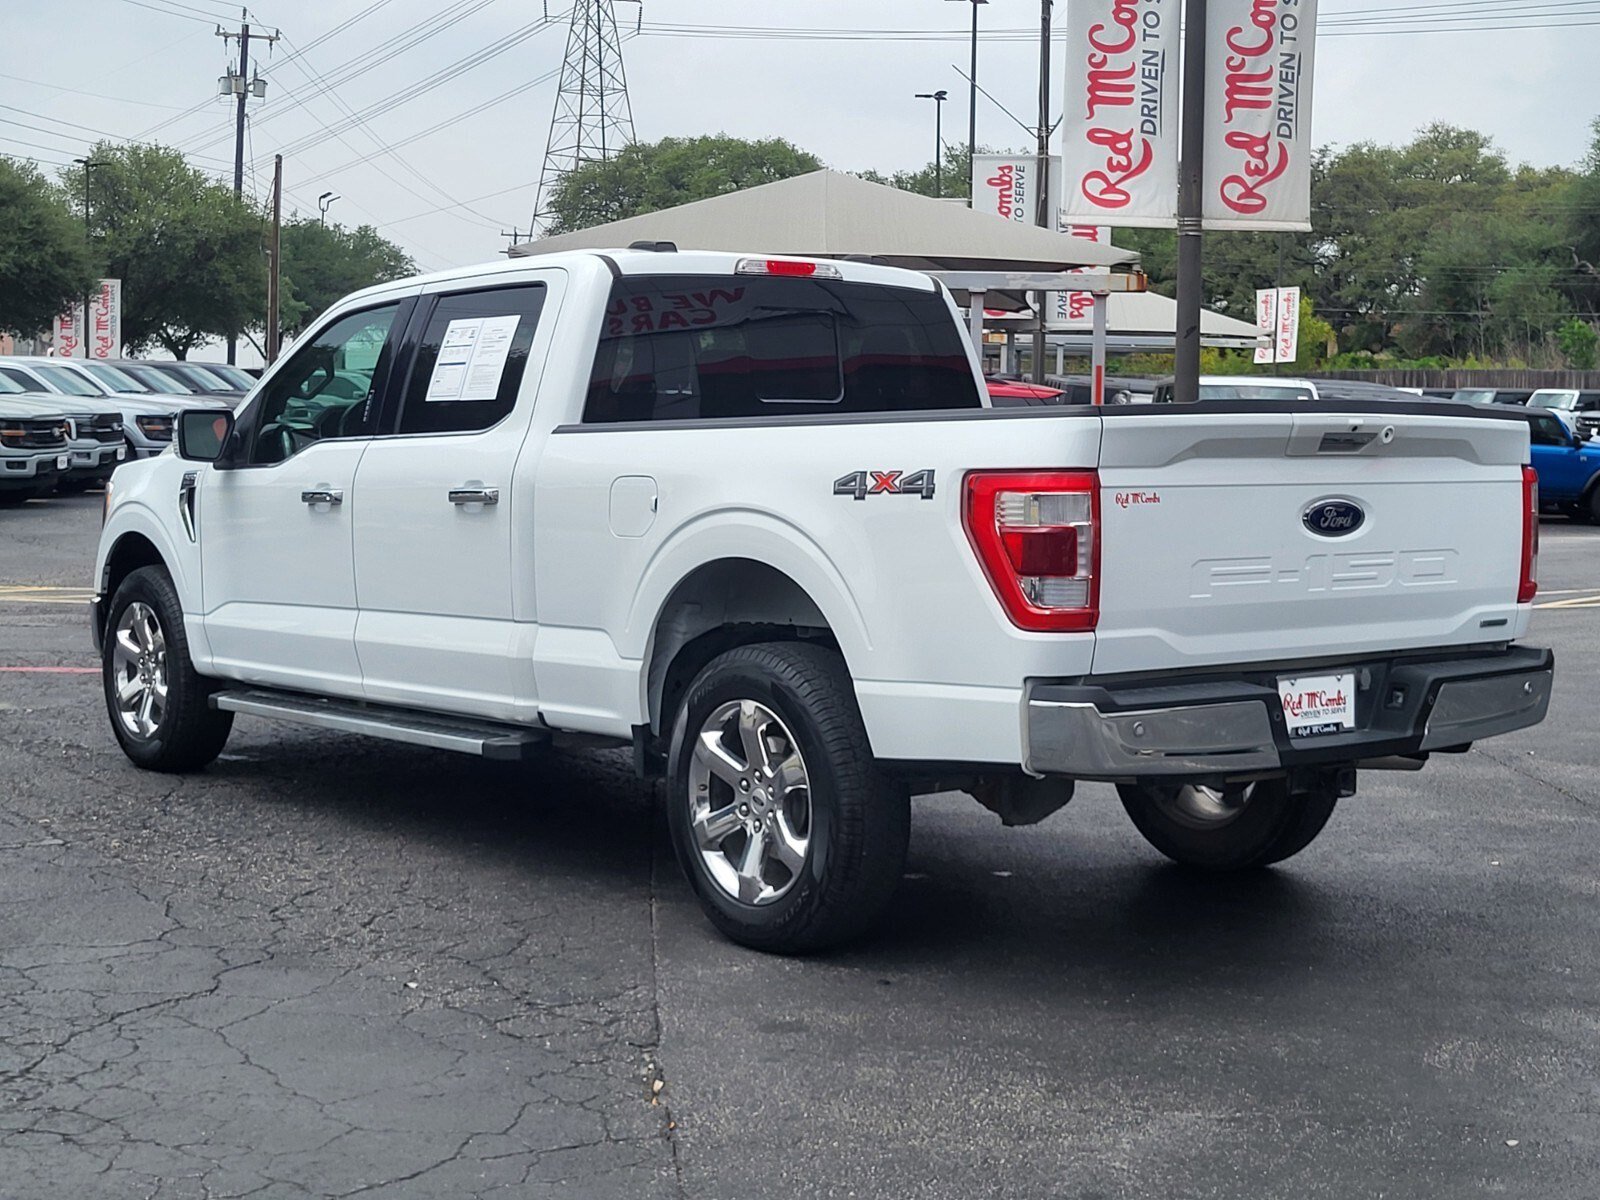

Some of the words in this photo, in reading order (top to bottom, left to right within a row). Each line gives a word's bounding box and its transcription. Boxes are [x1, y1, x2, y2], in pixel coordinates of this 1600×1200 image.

[1143, 10, 1160, 42] TO
[1280, 13, 1298, 44] TO
[1140, 50, 1160, 136] DRIVEN
[1277, 52, 1296, 140] DRIVEN
[987, 165, 1013, 218] ombs
[1014, 164, 1025, 205] SERVE
[1082, 128, 1153, 208] Red
[1220, 131, 1289, 214] Red
[1320, 506, 1354, 528] Ford
[1190, 548, 1459, 598] F-150
[1283, 692, 1303, 716] Red
[1305, 690, 1347, 708] McCombs
